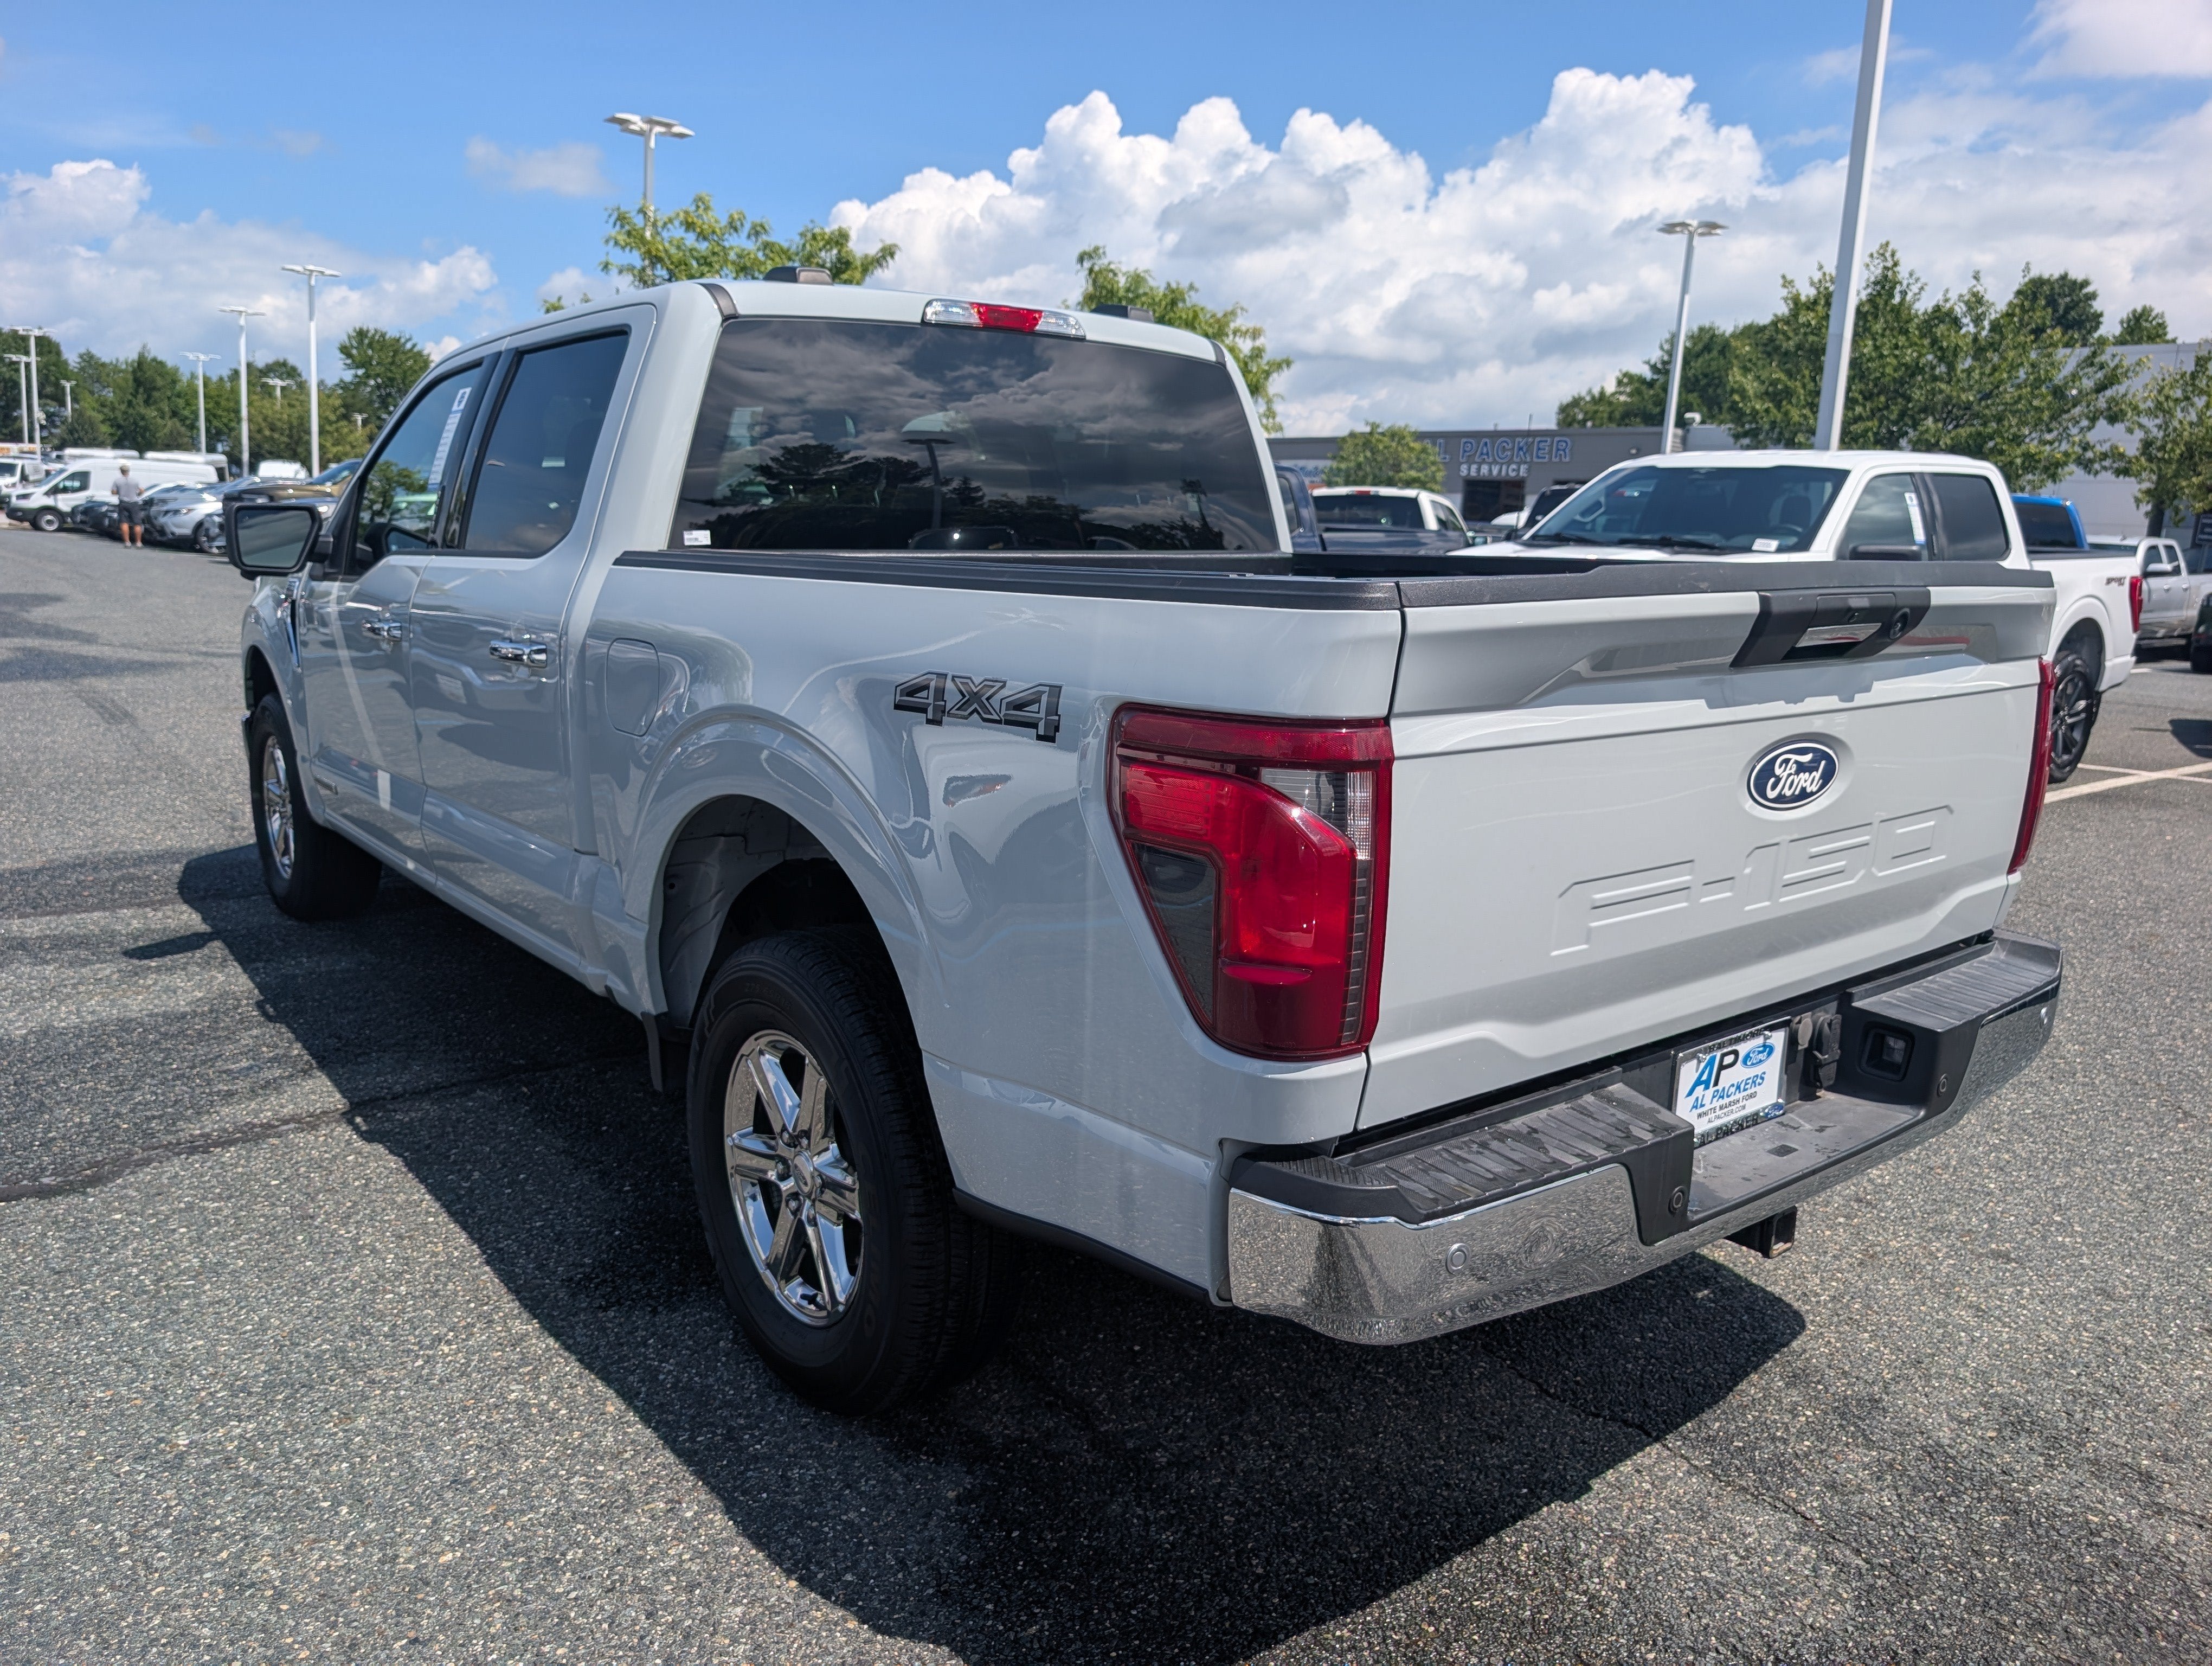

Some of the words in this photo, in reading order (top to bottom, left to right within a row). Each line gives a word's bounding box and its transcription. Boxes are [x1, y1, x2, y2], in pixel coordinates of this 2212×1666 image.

[1422, 438, 1451, 462] L
[1459, 437, 1571, 463] PACKER
[1459, 463, 1529, 477] SERVICE
[1766, 752, 1826, 799] Ford
[1549, 805, 1954, 956] F-150
[1689, 1093, 1706, 1112] AL
[1710, 1071, 1766, 1104] PACKERS
[1697, 1106, 1717, 1120] WHITE
[1718, 1097, 1740, 1111] MARSH
[1741, 1091, 1758, 1103] FORD
[1707, 1103, 1746, 1124] ALPACKER.COM
